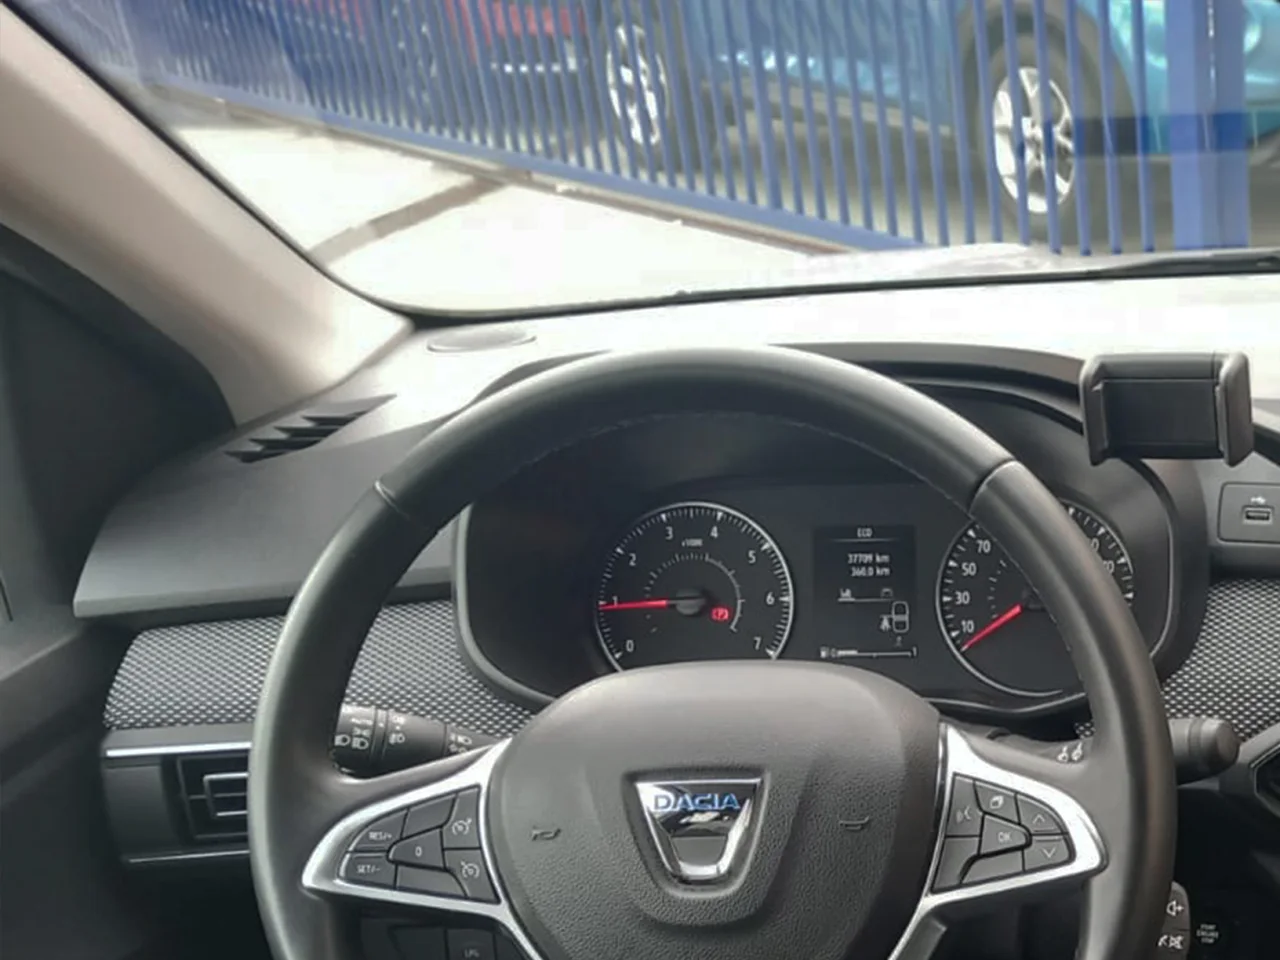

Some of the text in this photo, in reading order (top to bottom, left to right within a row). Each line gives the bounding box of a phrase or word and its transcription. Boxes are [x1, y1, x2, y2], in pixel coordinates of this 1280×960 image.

[665, 526, 674, 540] 3
[710, 526, 719, 538] 4
[857, 527, 873, 538] ECO
[977, 539, 991, 554] 70
[629, 553, 637, 567] 2
[748, 550, 757, 564] 5
[875, 553, 890, 563] km
[875, 566, 890, 576] km
[962, 562, 977, 576] 50
[766, 592, 775, 606] 6
[955, 591, 971, 605] 30
[961, 619, 975, 634] 10
[626, 639, 634, 652] 0
[754, 637, 761, 650] 7
[653, 792, 741, 812] DACIA
[998, 831, 1013, 842] OK
